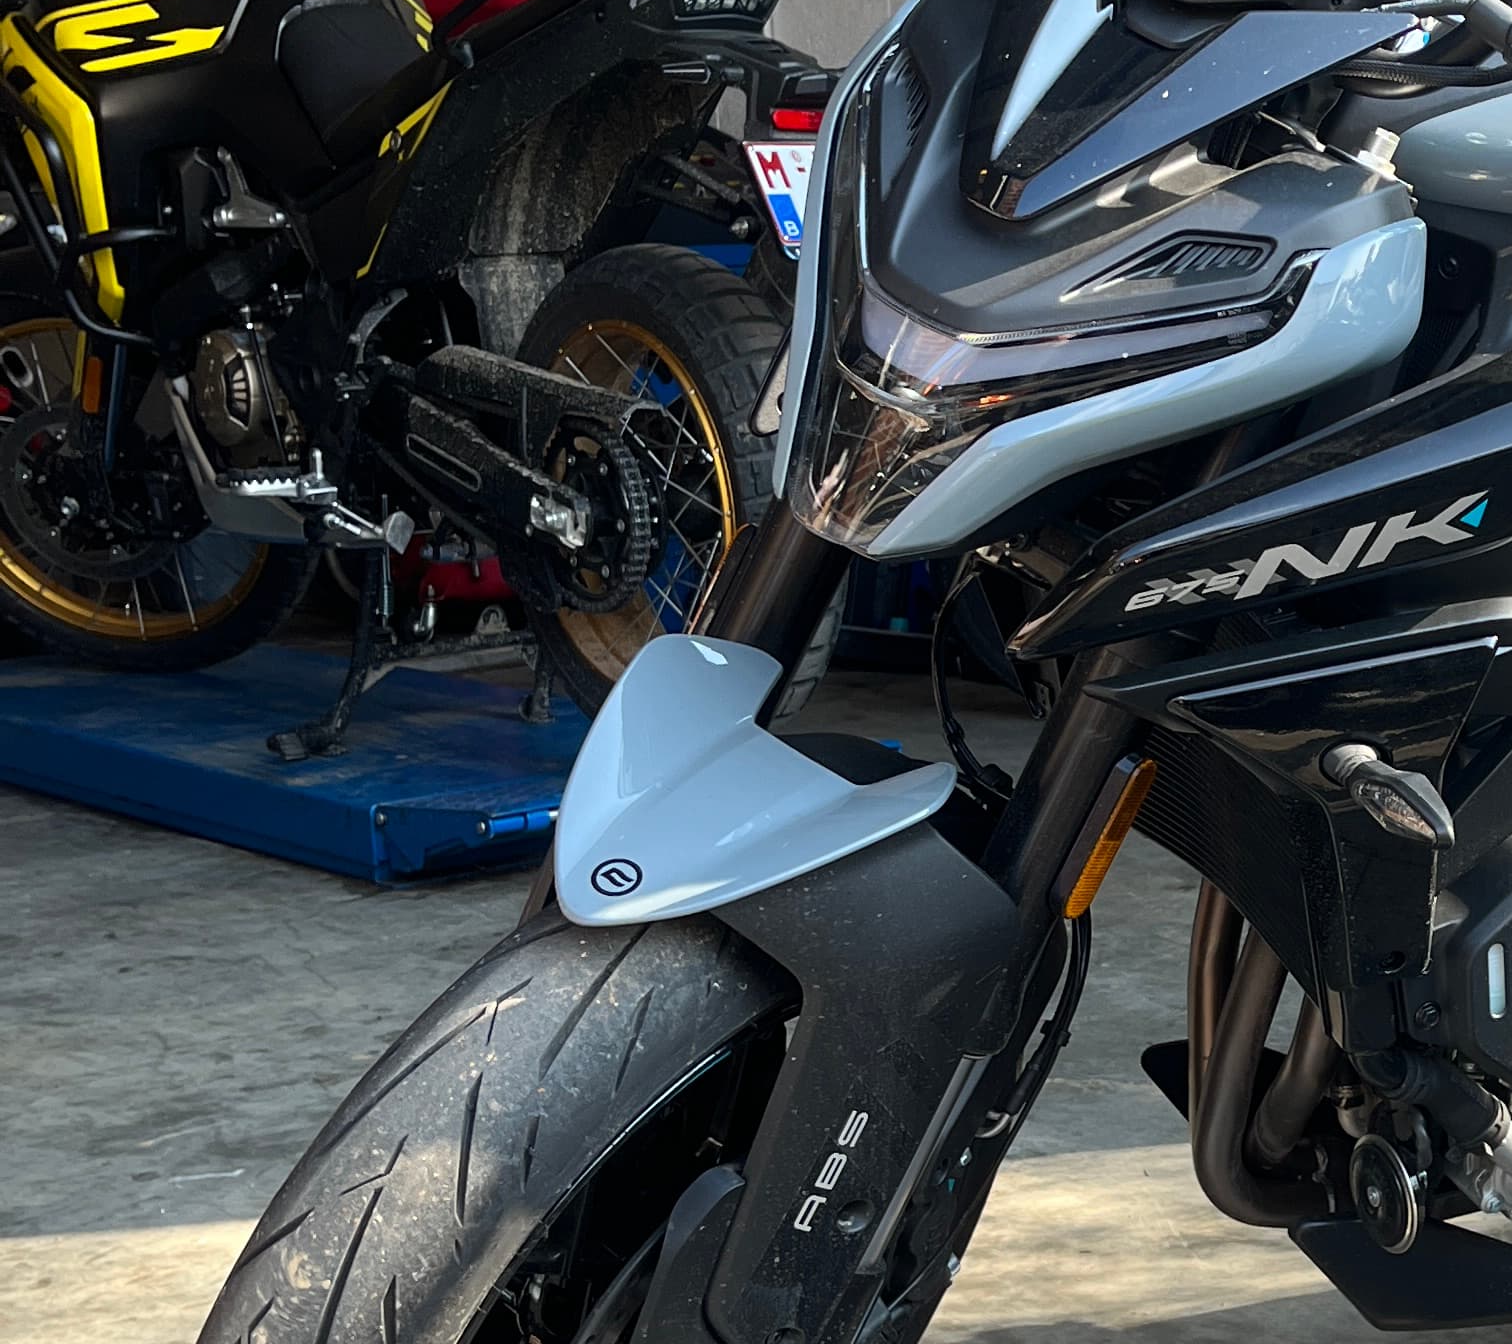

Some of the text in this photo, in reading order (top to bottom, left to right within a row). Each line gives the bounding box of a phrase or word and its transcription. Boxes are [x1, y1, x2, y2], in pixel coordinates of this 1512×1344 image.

[784, 220, 800, 237] B
[1124, 489, 1489, 612] 675 NK
[794, 1110, 869, 1232] ABS
